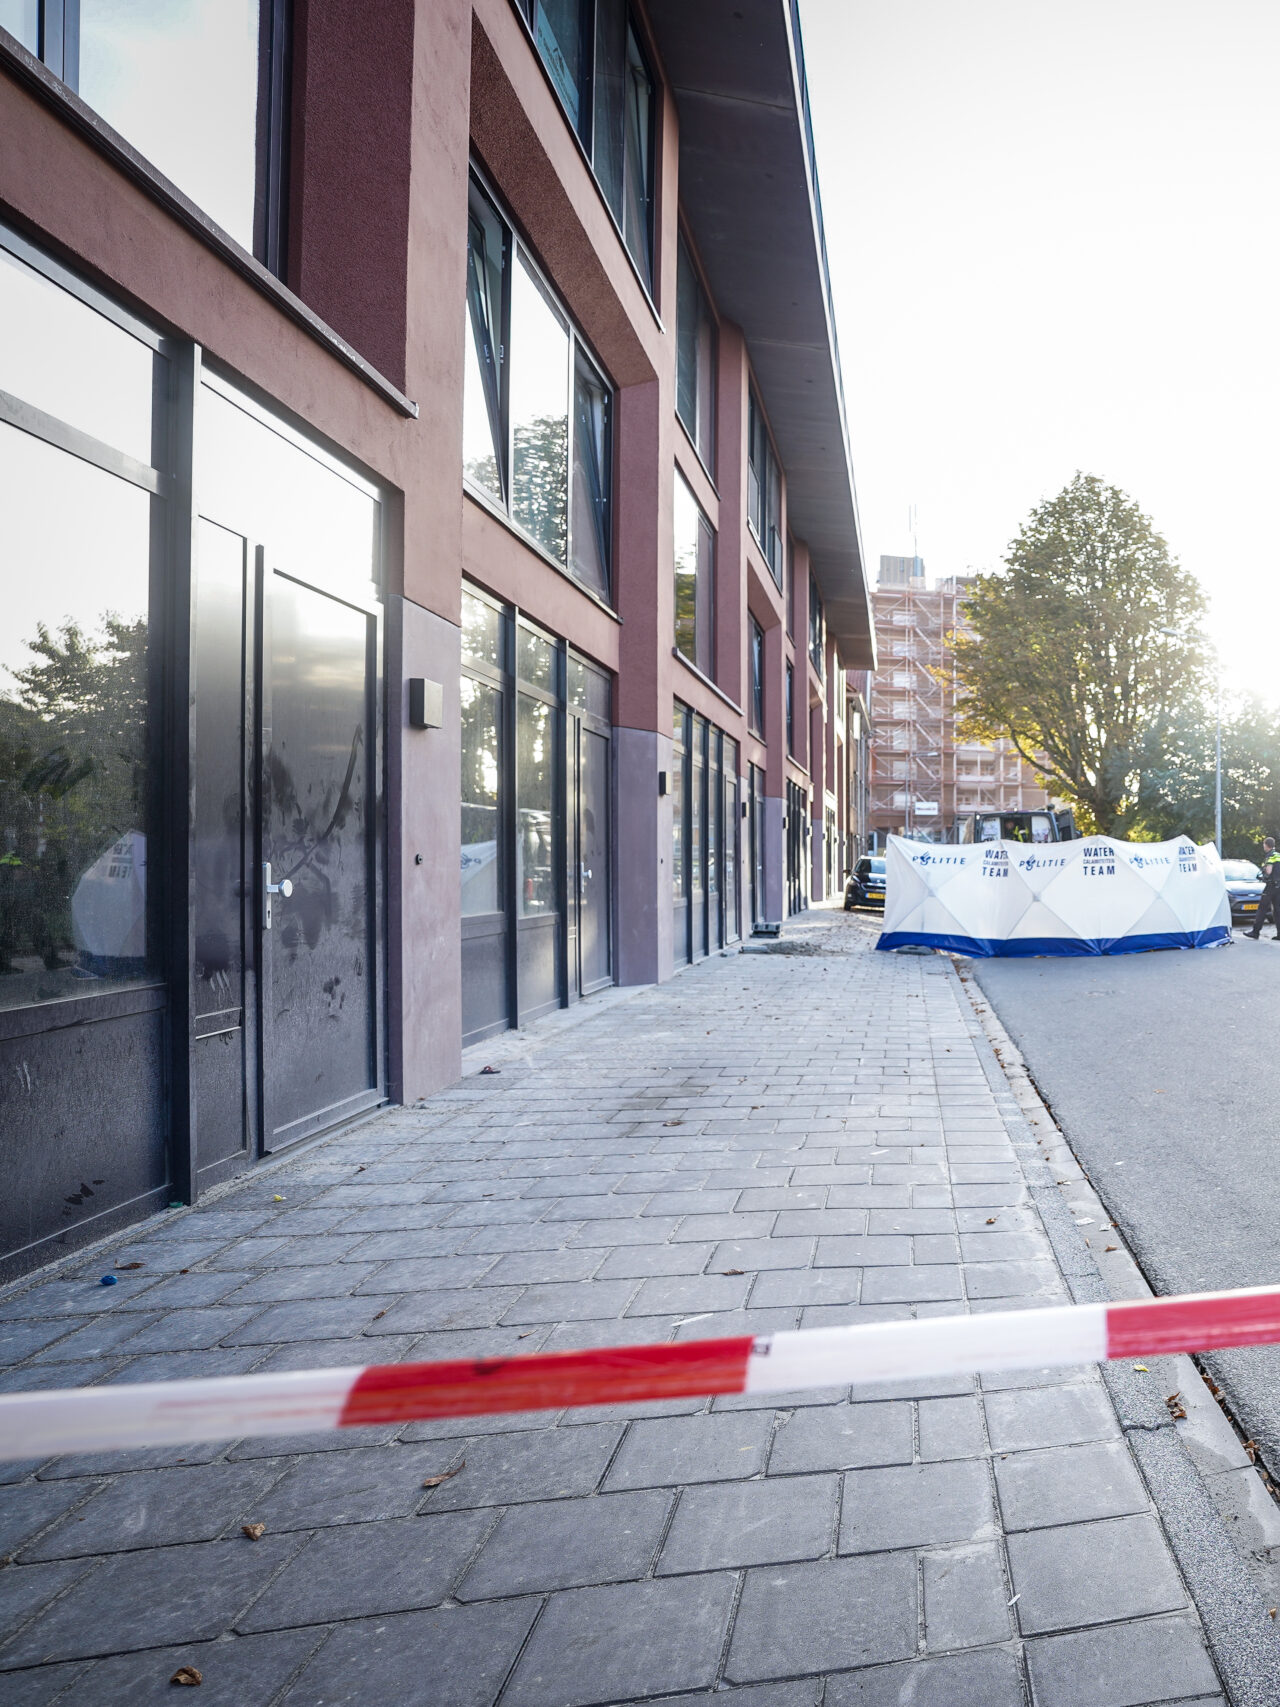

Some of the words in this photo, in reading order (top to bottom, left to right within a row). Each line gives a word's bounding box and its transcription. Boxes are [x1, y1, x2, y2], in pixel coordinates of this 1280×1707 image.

[985, 849, 1009, 859] WAT
[1083, 847, 1115, 857] WATER
[982, 867, 1009, 877] TEAM
[1083, 865, 1115, 875] TEAM
